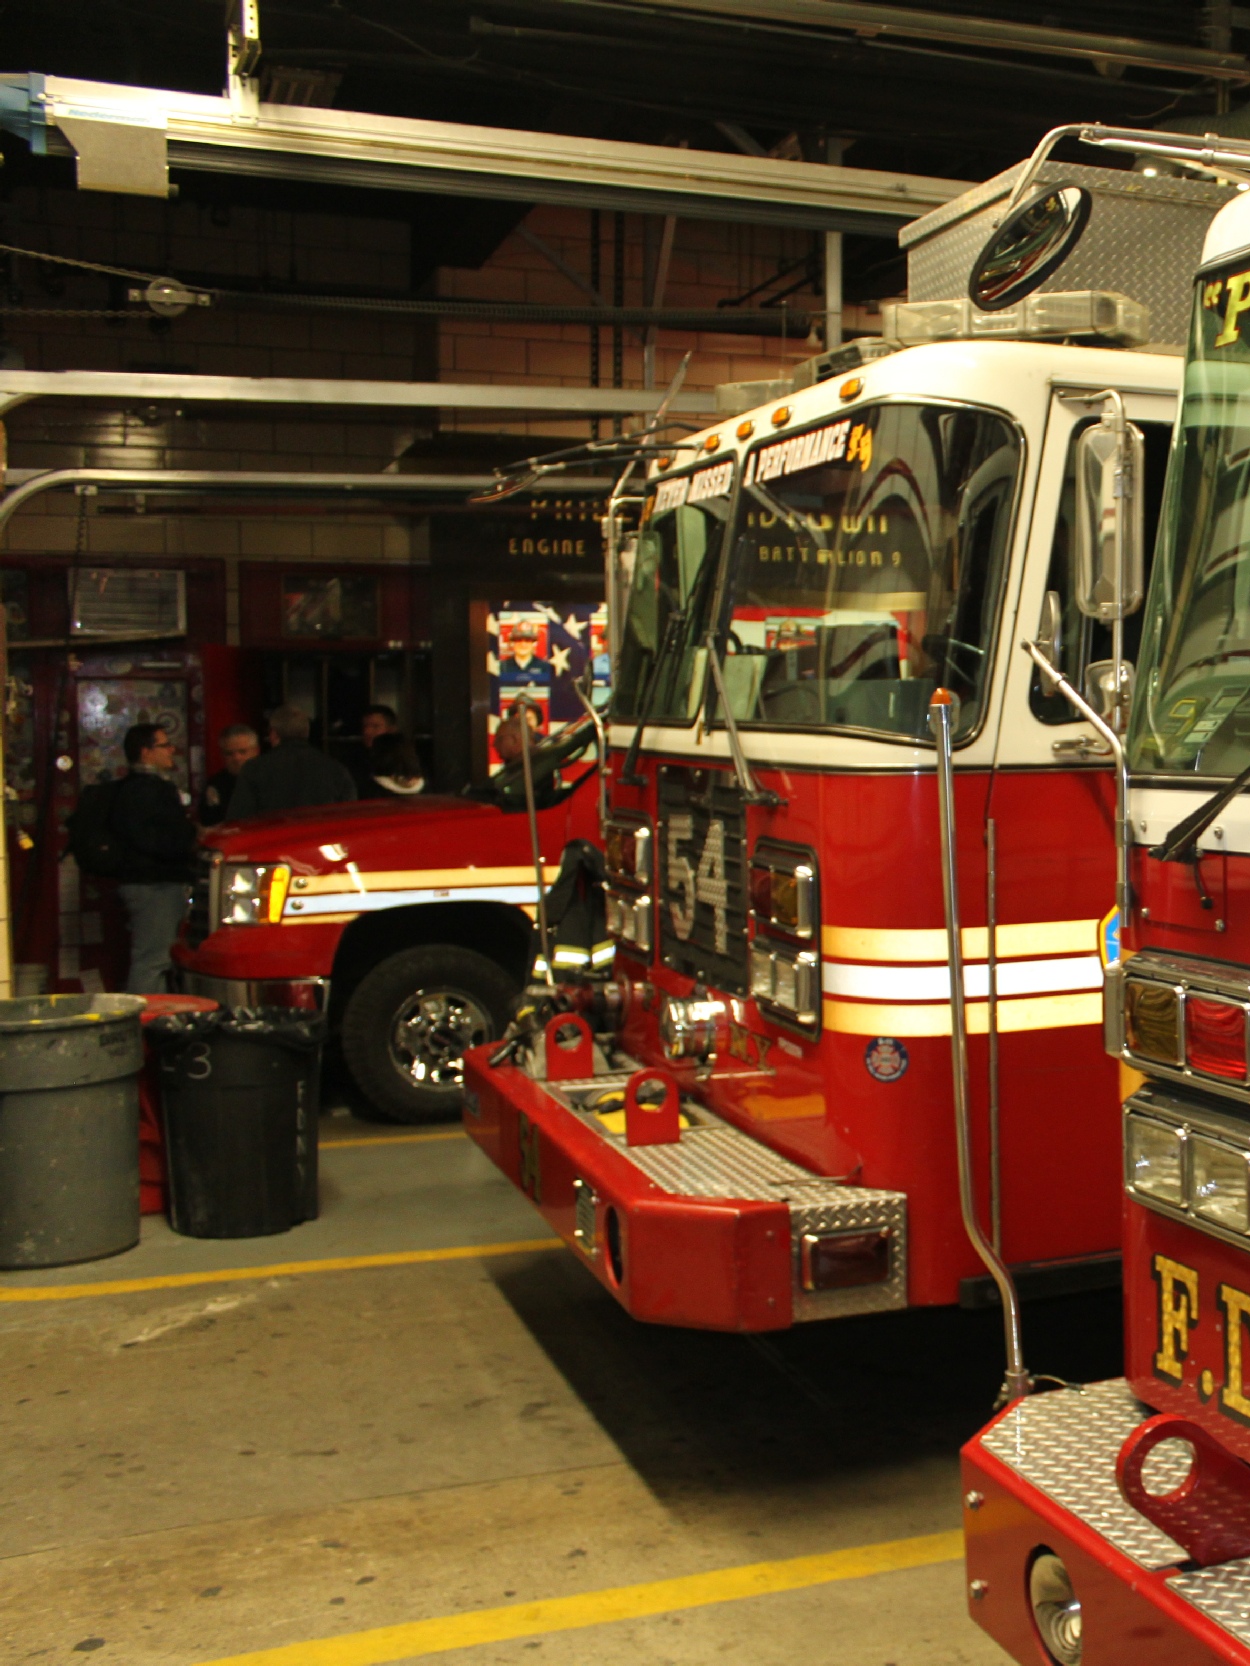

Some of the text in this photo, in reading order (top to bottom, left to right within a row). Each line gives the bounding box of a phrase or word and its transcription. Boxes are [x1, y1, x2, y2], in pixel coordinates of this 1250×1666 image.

[755, 419, 851, 483] PERFORMANCE
[508, 538, 586, 557] ENGINE
[668, 814, 728, 955] 54
